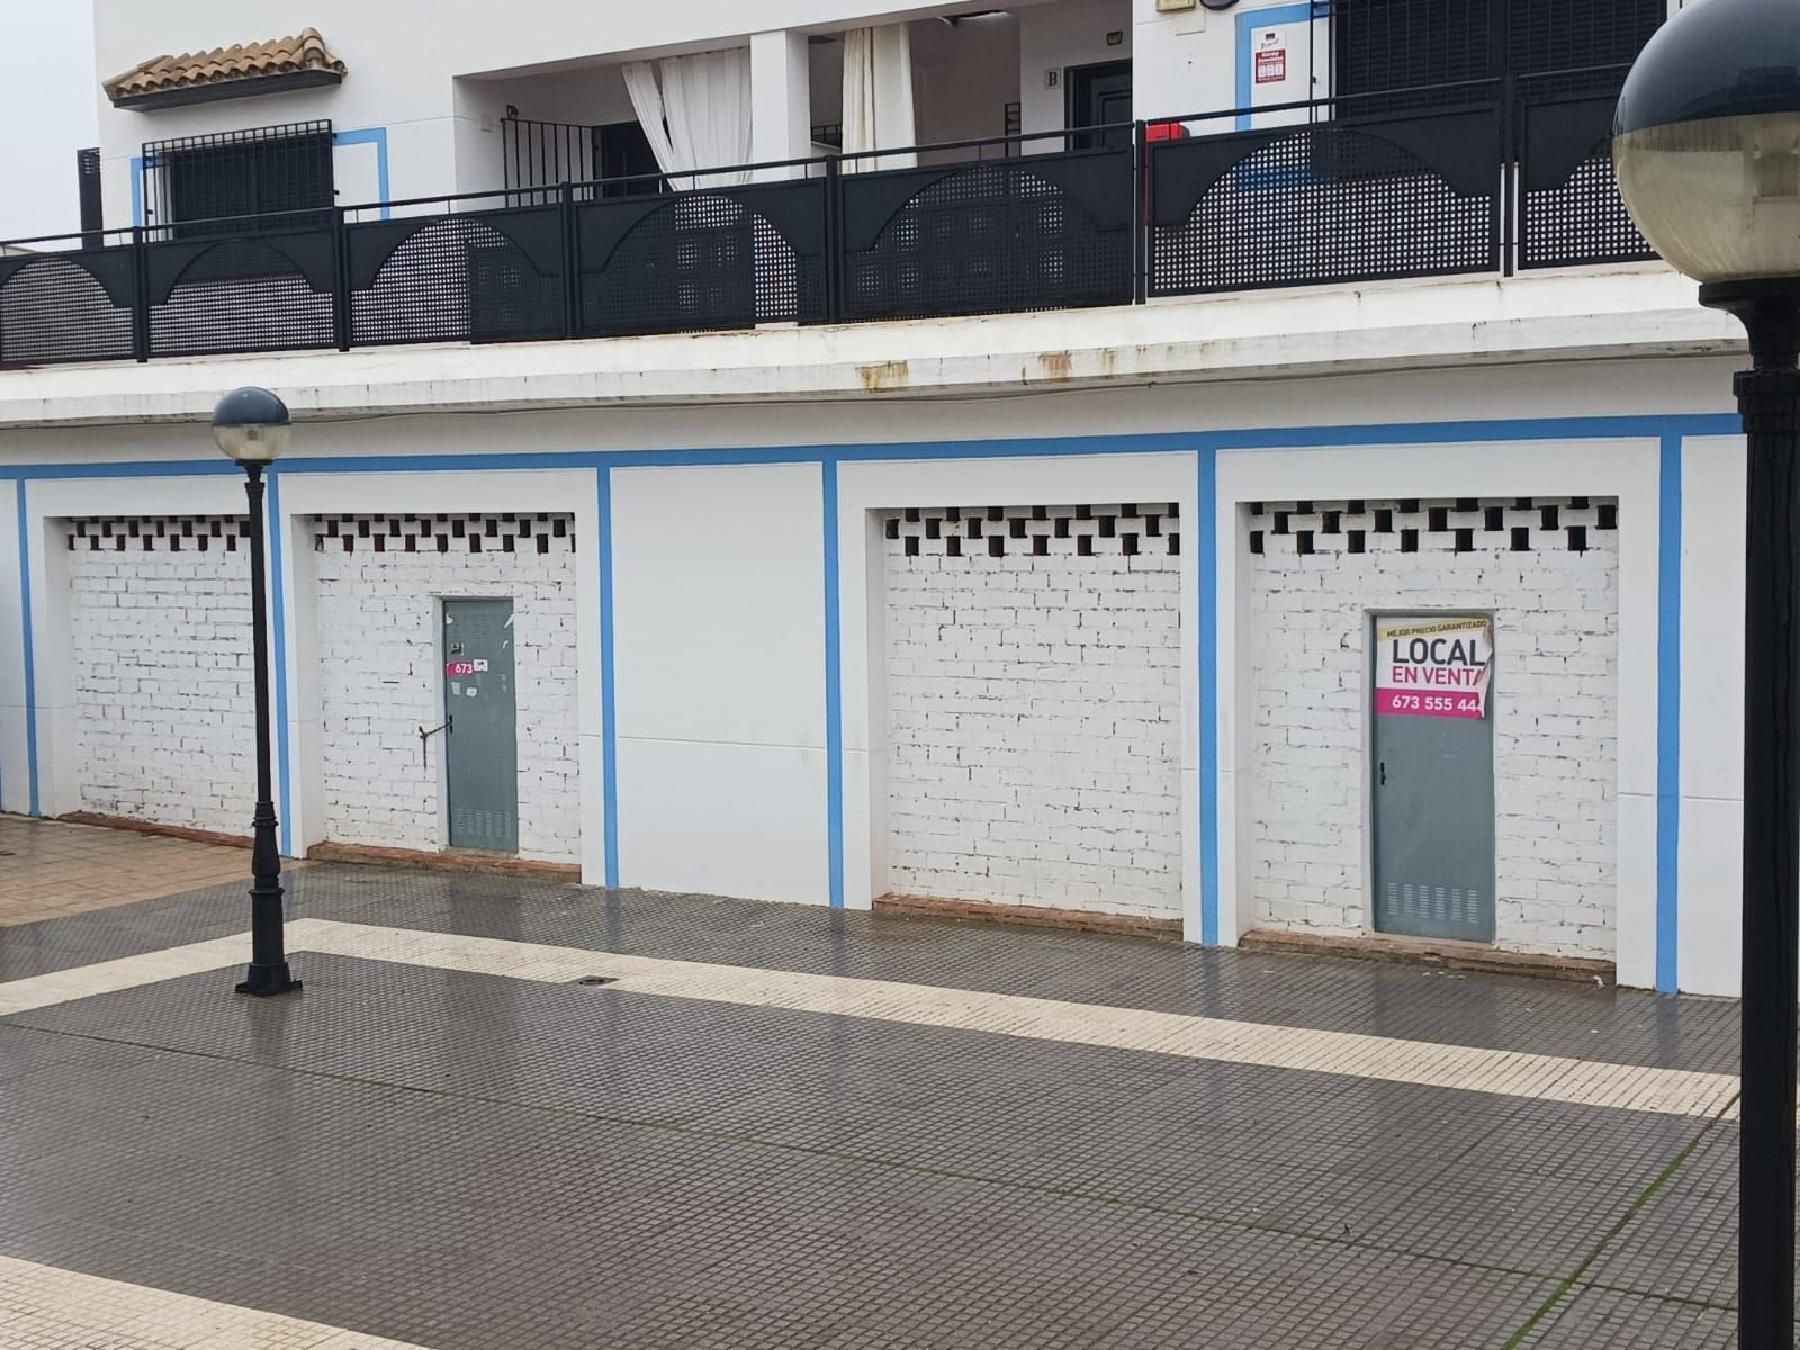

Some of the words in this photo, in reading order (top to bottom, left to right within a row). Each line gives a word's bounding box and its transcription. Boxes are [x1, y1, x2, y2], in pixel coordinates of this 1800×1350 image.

[1048, 71, 1057, 87] B
[1387, 628, 1410, 637] MEJOR
[1412, 626, 1436, 635] PRECIO
[1438, 620, 1487, 632] GARANTIZADO
[1393, 638, 1485, 666] LOCAL
[456, 663, 472, 674] 673
[1392, 666, 1417, 683] EN
[1392, 695, 1420, 709] 673
[1424, 696, 1452, 710] 555
